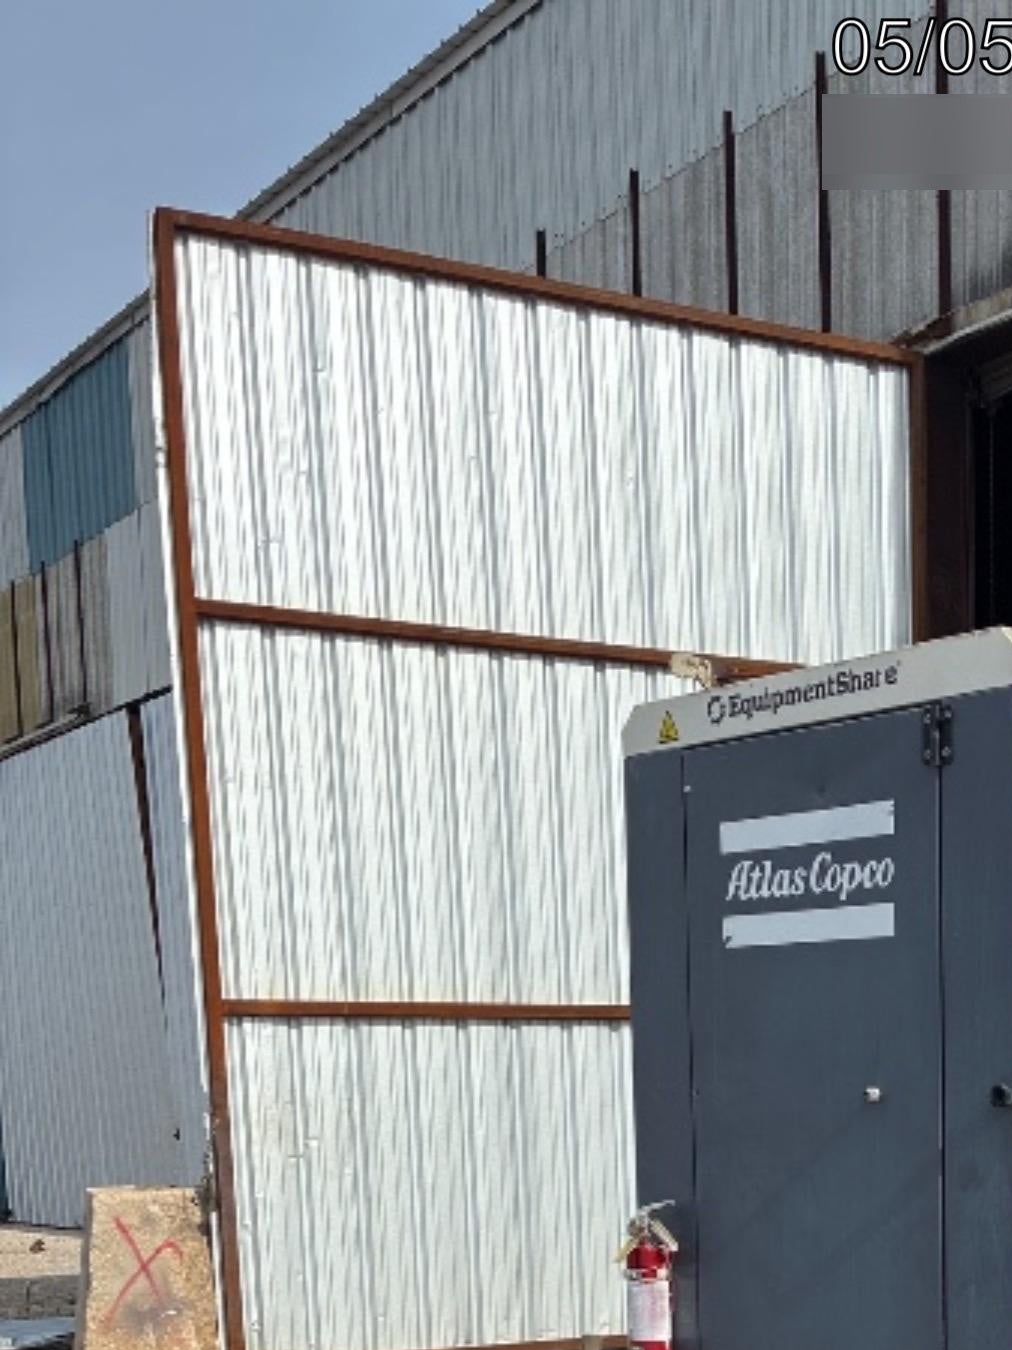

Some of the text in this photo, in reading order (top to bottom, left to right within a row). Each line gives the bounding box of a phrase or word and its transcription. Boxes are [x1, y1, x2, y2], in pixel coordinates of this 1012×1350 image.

[728, 664, 898, 720] EquipmentShare
[725, 852, 895, 901] Atlas Copco
